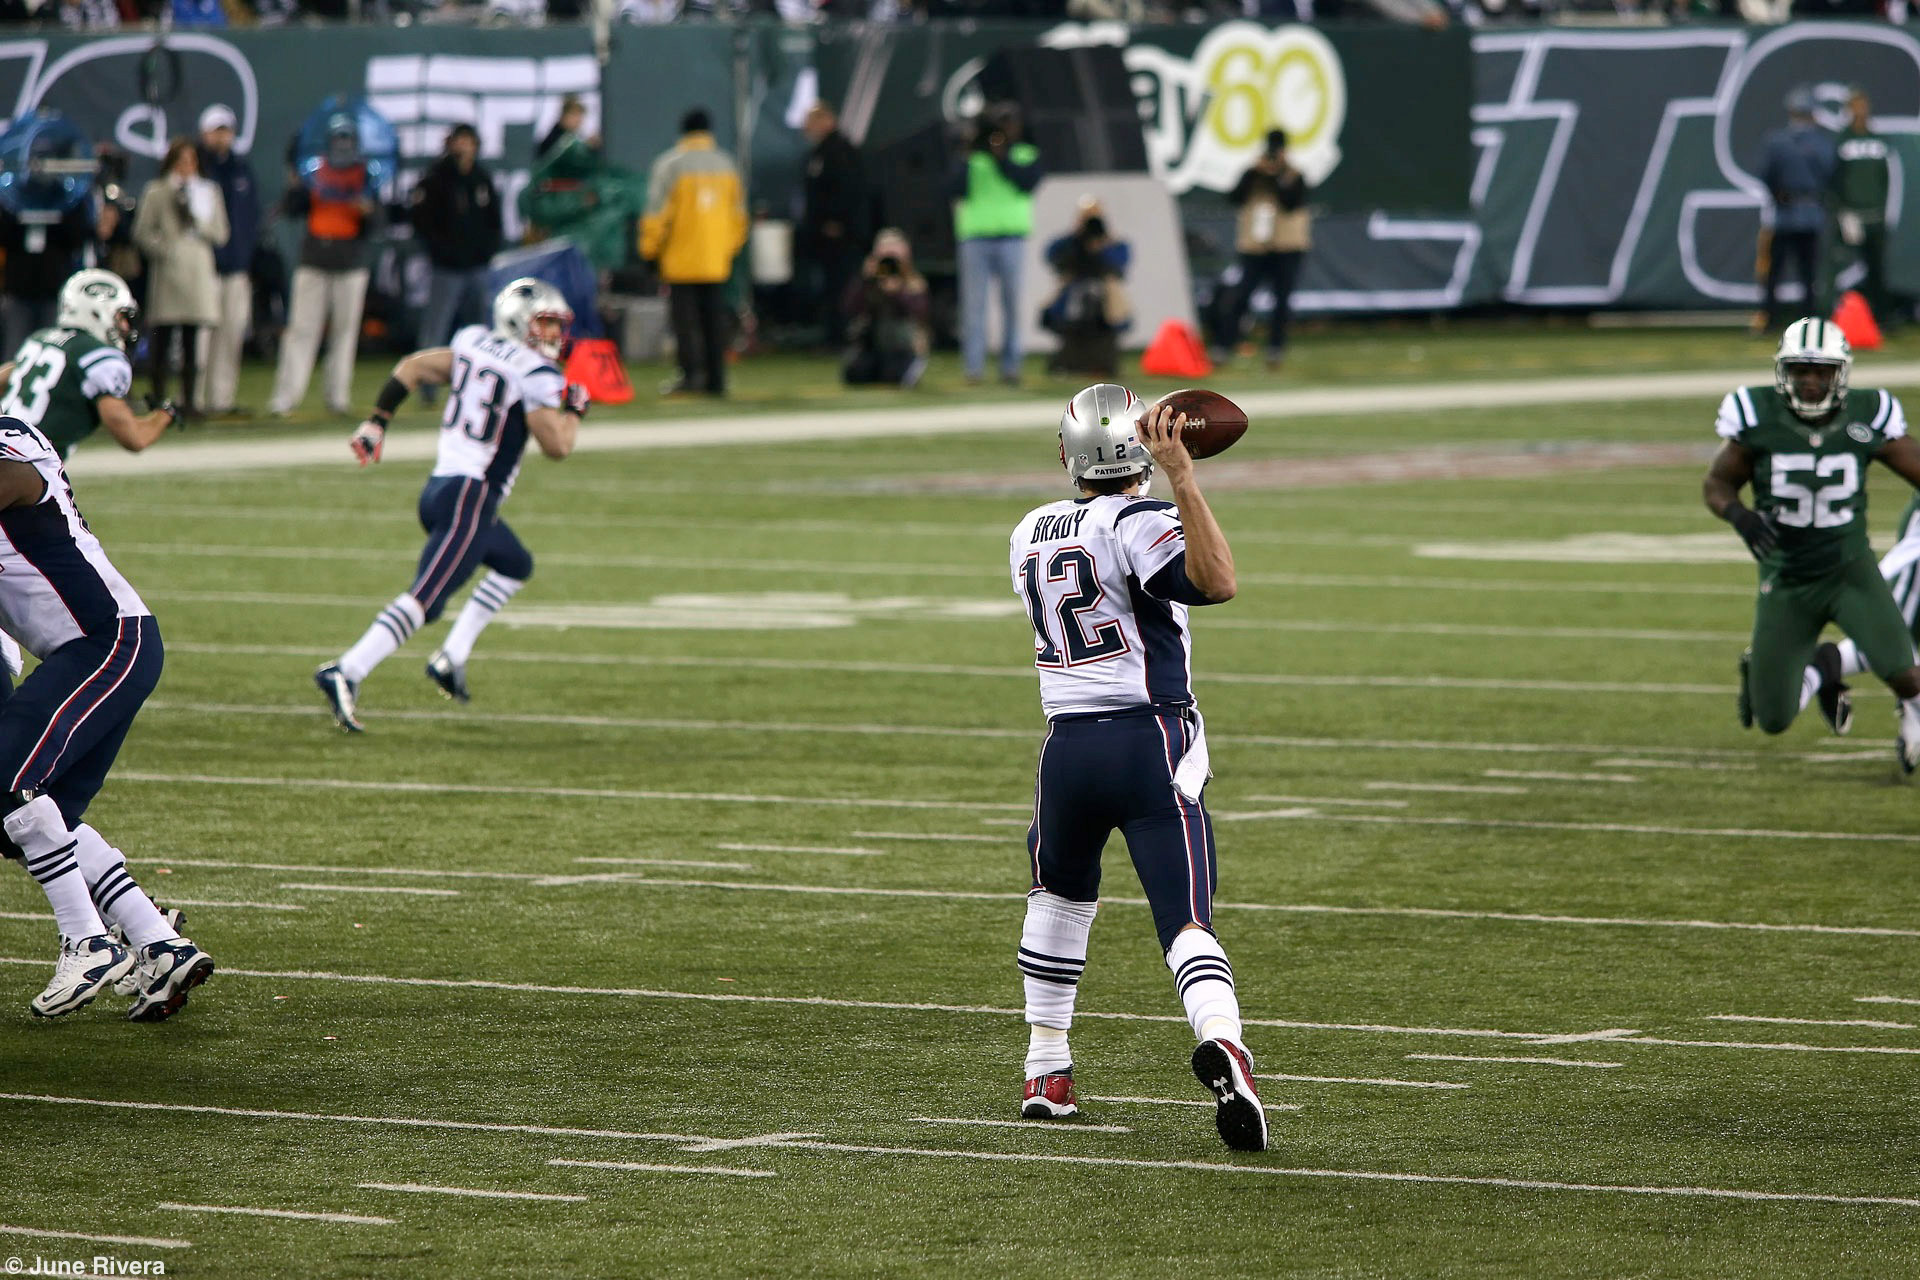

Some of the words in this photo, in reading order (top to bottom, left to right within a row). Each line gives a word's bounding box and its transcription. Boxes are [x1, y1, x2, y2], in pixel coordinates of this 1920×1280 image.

[1209, 46, 1329, 148] 60
[1094, 465, 1132, 476] PATRIOTS
[1770, 452, 1859, 528] 52
[1030, 508, 1090, 545] BRADY
[1019, 545, 1131, 668] 12
